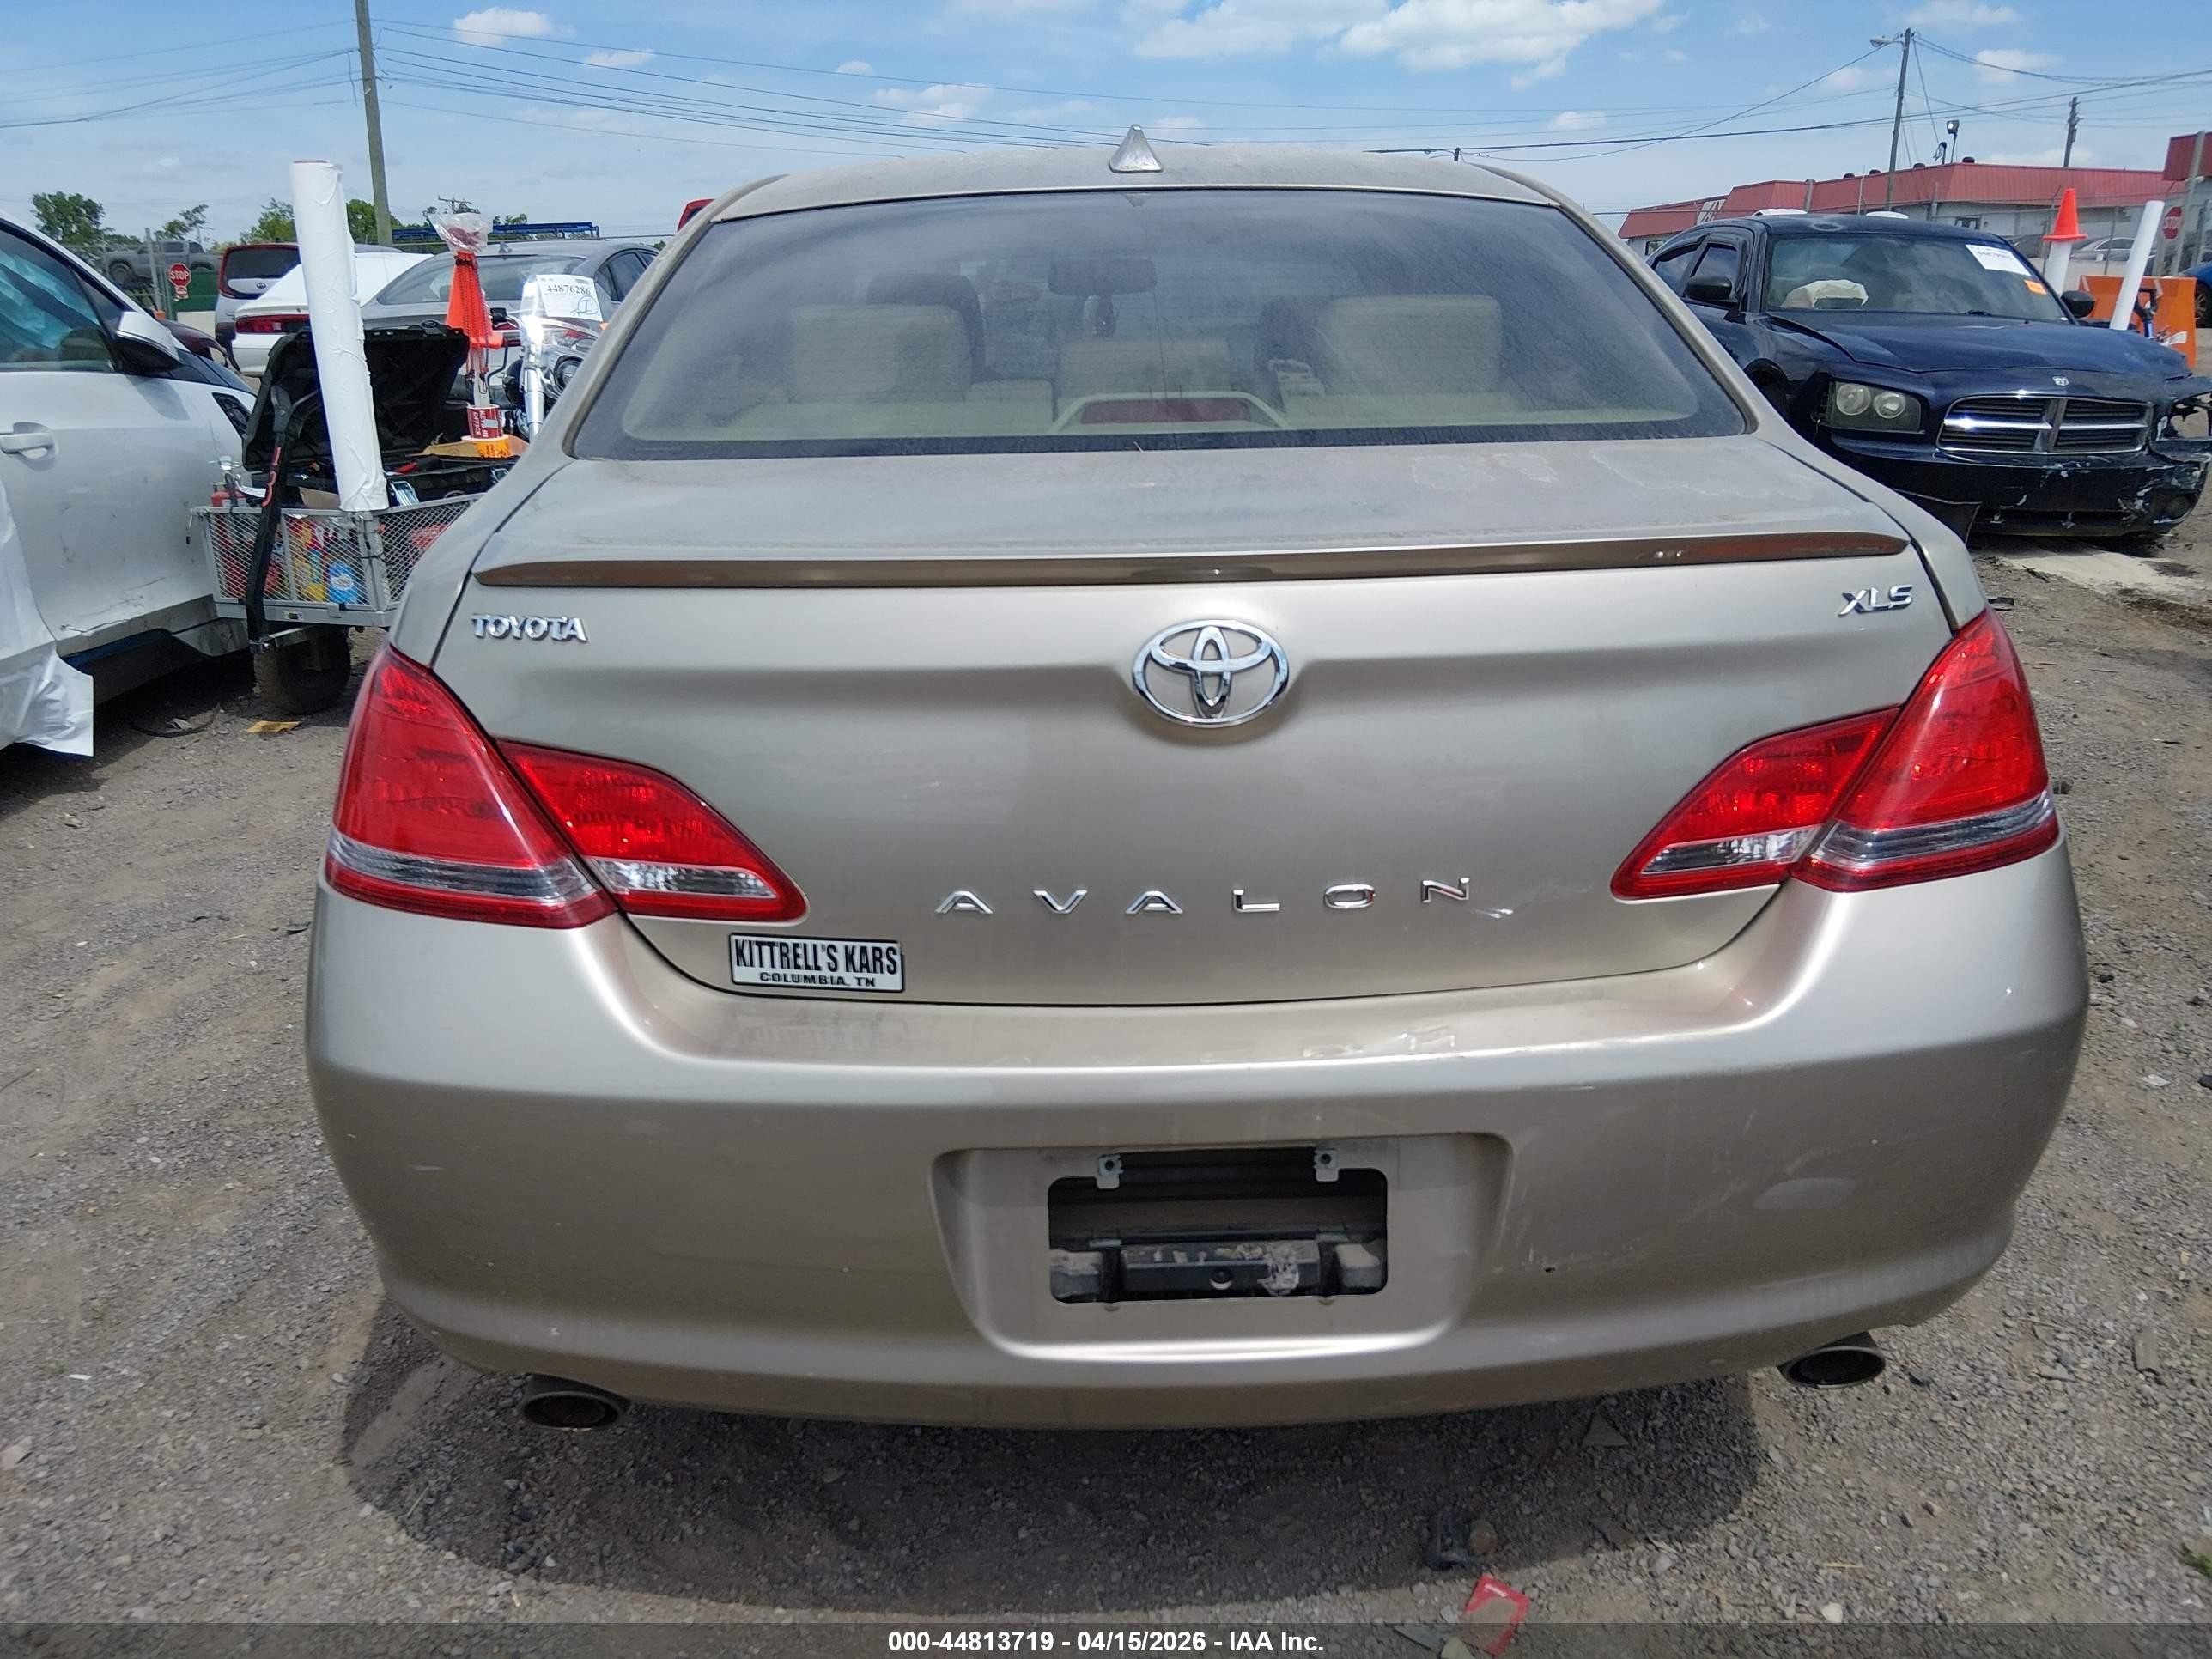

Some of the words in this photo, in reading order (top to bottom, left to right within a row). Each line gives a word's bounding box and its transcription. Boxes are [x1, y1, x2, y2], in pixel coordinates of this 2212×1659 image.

[170, 270, 189, 280] STOP
[547, 284, 591, 295] 44876286
[473, 411, 482, 436] OFFICE
[1838, 584, 1912, 617] XLS
[471, 613, 588, 643] TOYOTA
[935, 877, 1470, 915] AVALON
[734, 939, 839, 973] KITTRELL'S
[844, 944, 898, 975] KARS
[854, 976, 877, 988] TN
